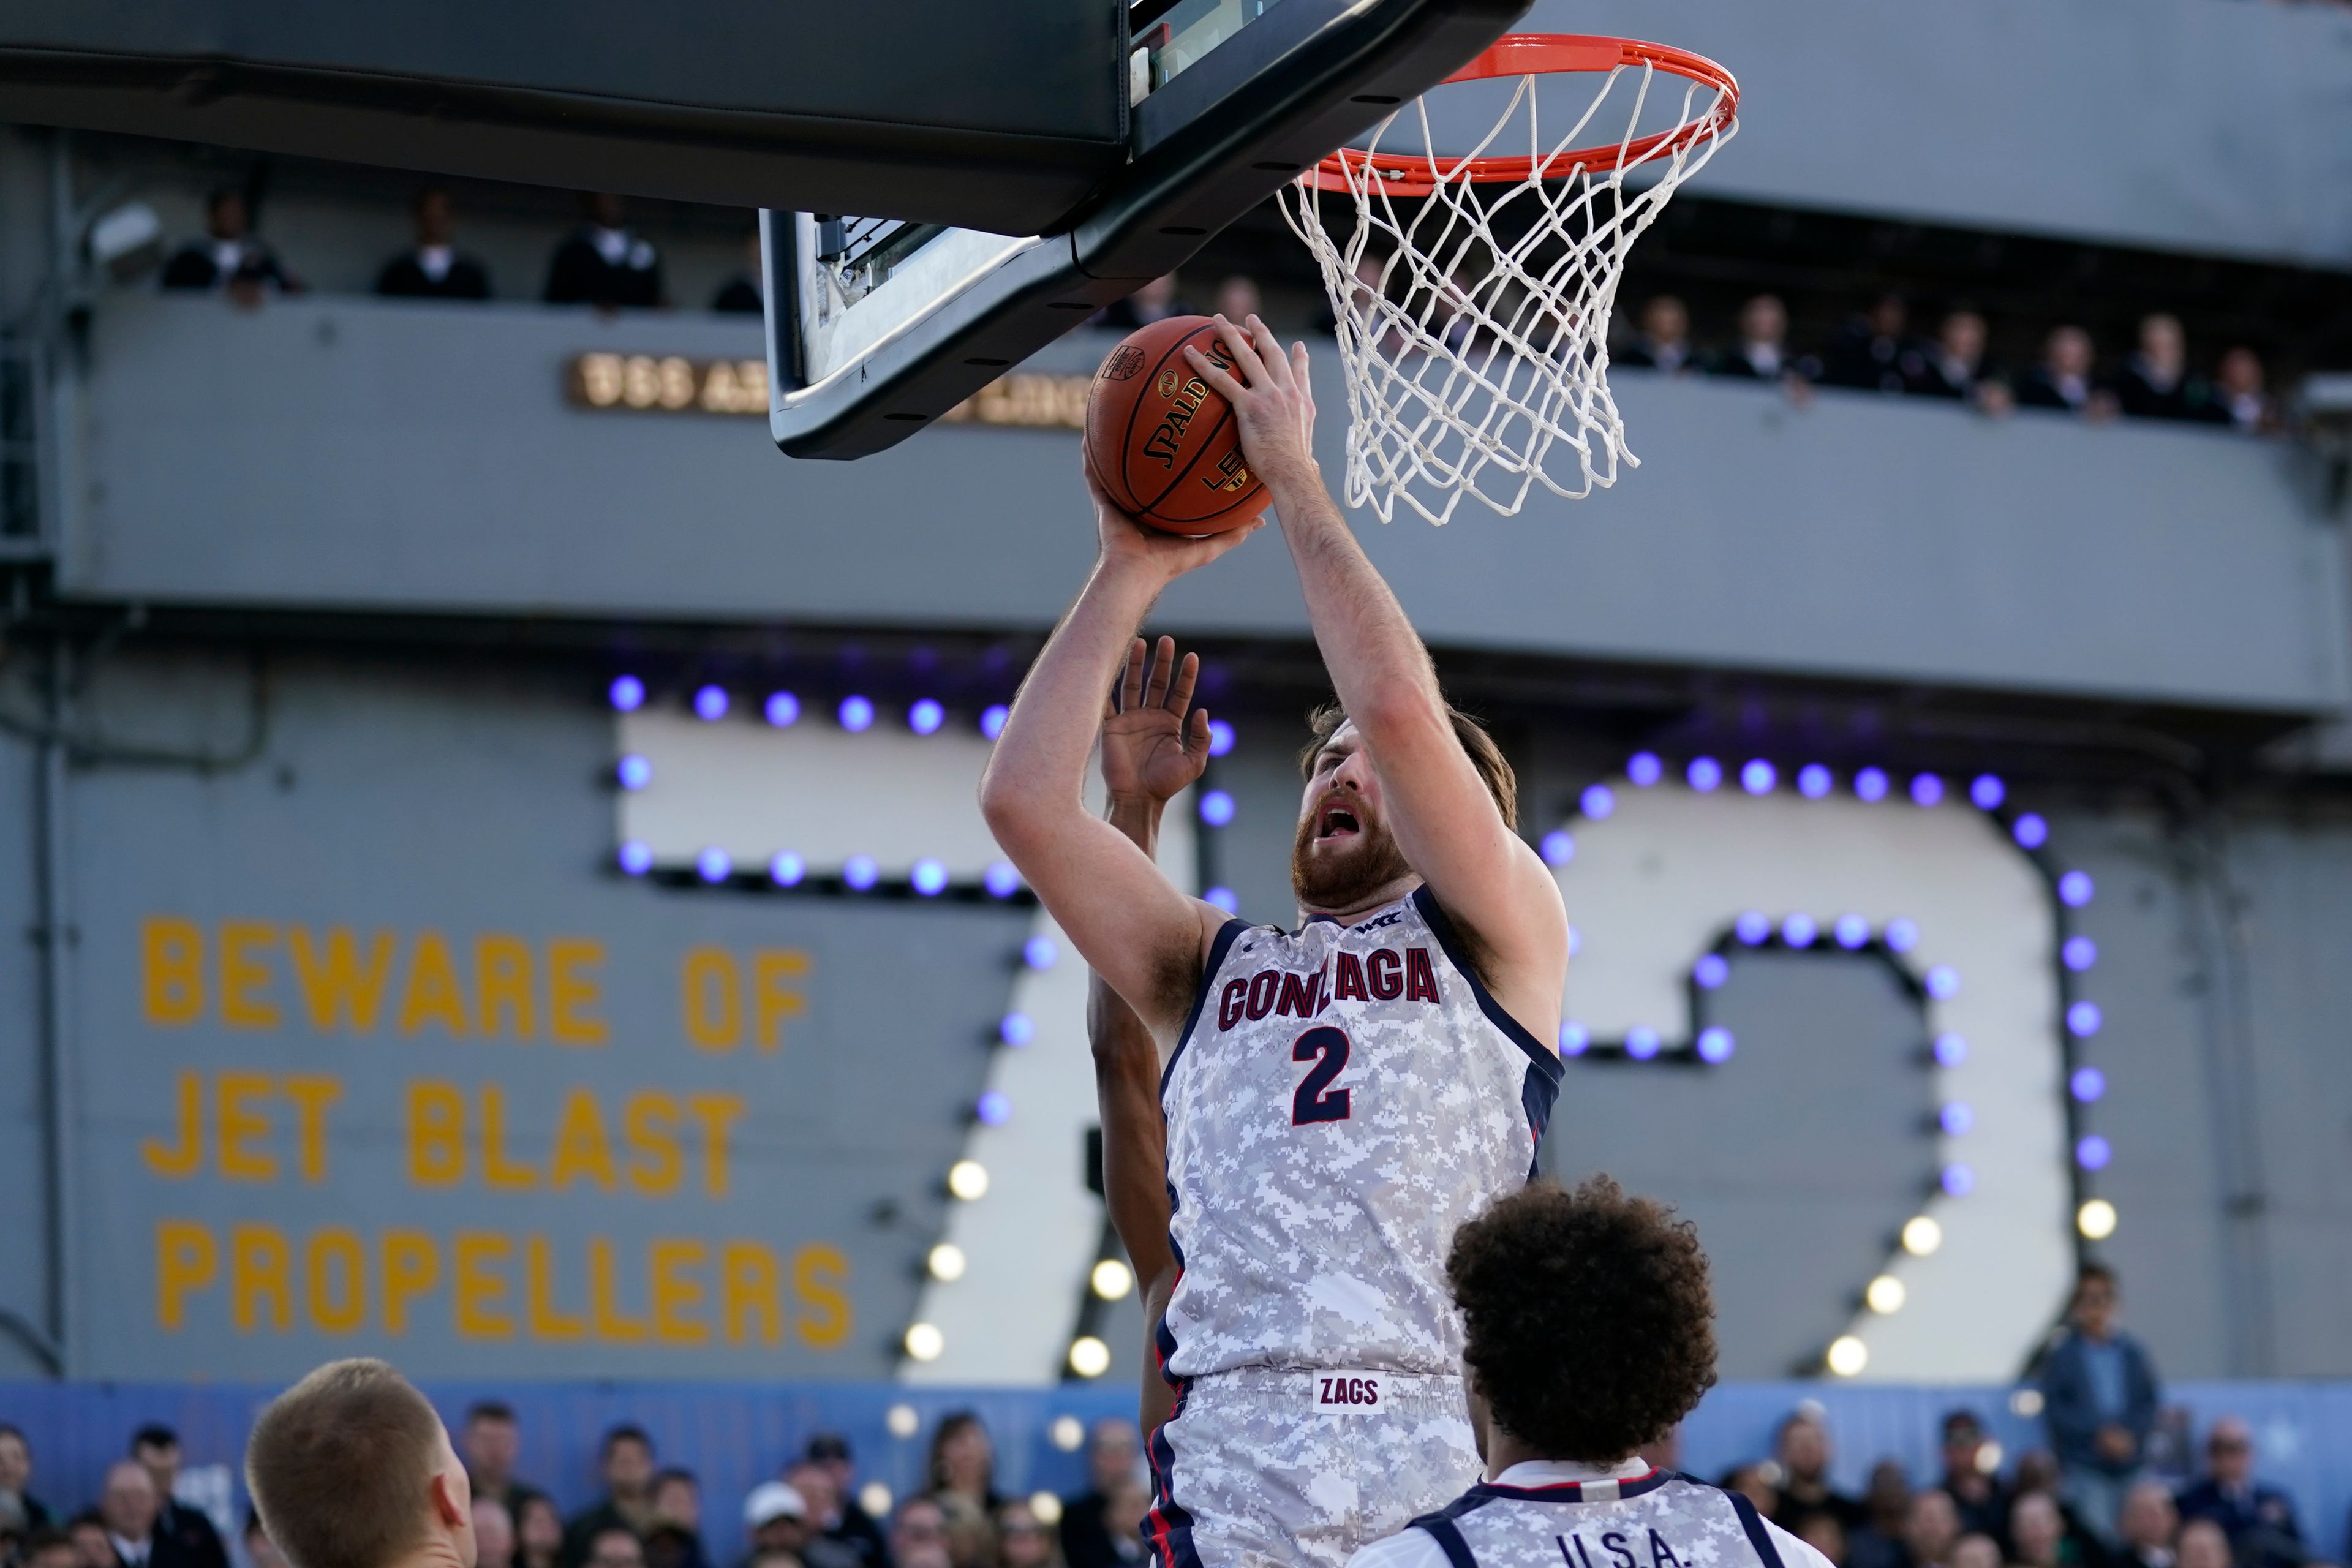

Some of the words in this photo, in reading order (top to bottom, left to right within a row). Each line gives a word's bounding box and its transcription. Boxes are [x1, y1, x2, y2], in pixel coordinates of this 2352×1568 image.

[1143, 338, 1238, 470] SPALDNG
[143, 919, 606, 1042] BEWARE
[685, 950, 807, 1049] OF
[1218, 948, 1441, 1032] GONZAGA
[1292, 1025, 1351, 1126] 2
[143, 1073, 341, 1179] JET
[407, 1081, 742, 1194] BLAST
[157, 1223, 850, 1347] PROPELLERS
[1320, 1378, 1378, 1405] ZAGS
[1556, 1528, 1692, 1568] USA.
